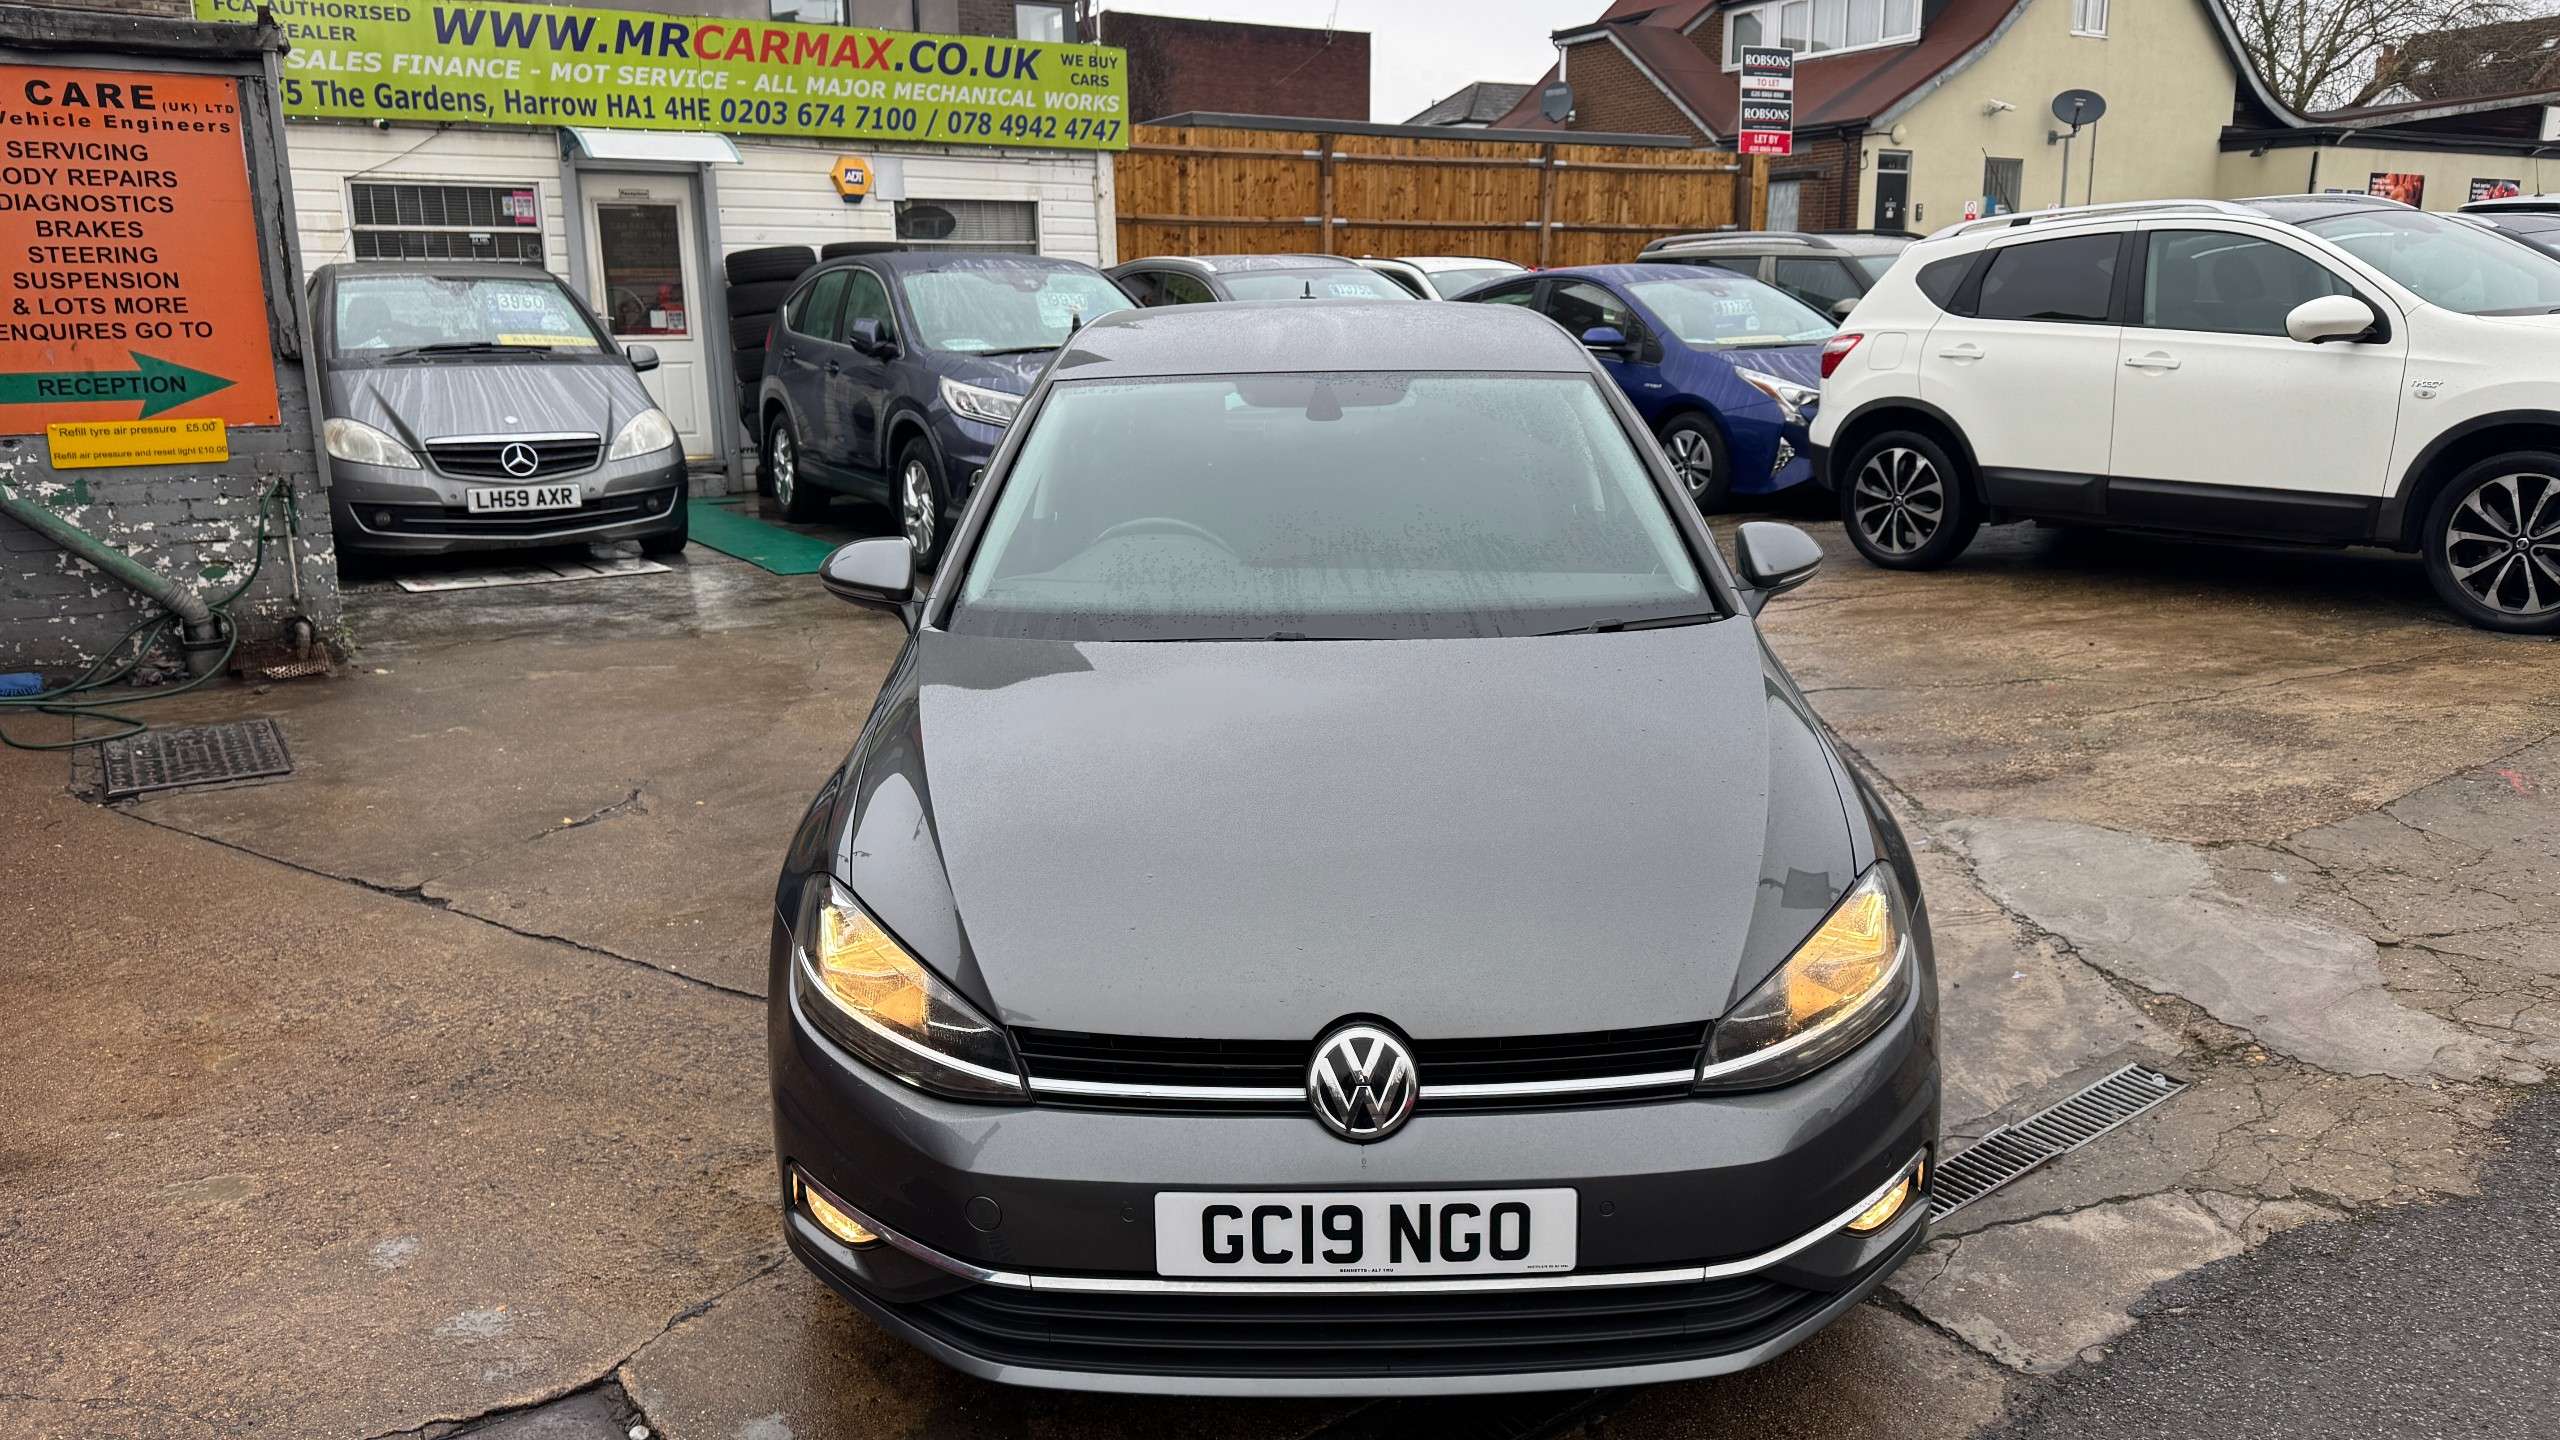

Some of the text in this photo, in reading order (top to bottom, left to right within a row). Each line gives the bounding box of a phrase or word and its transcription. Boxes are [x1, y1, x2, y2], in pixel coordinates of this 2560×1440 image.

[213, 0, 411, 22] FCA AUTHORISED
[286, 23, 357, 42] EALER
[433, 7, 1042, 80] WWW.MRCARMAX.CO.UK
[1061, 53, 1118, 69] WE BUY
[1745, 54, 1791, 68] ROBSONS
[287, 49, 381, 72] SALES
[393, 53, 521, 80] FINANCE
[551, 62, 610, 83] MOT
[617, 66, 729, 90] SERVICE
[754, 73, 797, 94] ALL
[806, 76, 886, 99] MAJOR
[893, 82, 1036, 108] MECHANICAL
[1044, 91, 1120, 112] WORKS
[1070, 73, 1109, 87] CARS
[25, 79, 235, 114] CARE (UK) LTD
[279, 77, 1121, 142] 5 The Gardens, Harrow HA1 4HE 0203 674 7100 / 078 4942 4747
[1744, 107, 1790, 121] ROBSONS
[104, 114, 231, 133] Engineers
[6, 141, 148, 162] SERVICING
[0, 167, 178, 188] ODY REPAIRS
[845, 170, 863, 183] ADT
[36, 220, 144, 239] BRAKES
[28, 246, 158, 264] STEERING
[13, 272, 180, 289] SUSPENSION
[13, 297, 188, 315] & LOTS MORE
[135, 322, 172, 339] GO
[180, 321, 213, 338] TO
[37, 375, 187, 396] RECEPTION
[59, 427, 87, 438] Refill
[90, 425, 110, 438] tyre
[114, 424, 127, 435] air
[130, 424, 177, 437] pressure
[53, 450, 77, 461] Refill
[80, 450, 90, 459] air
[93, 449, 132, 461] pressure
[135, 448, 151, 458] and
[153, 447, 175, 457] reset
[177, 445, 196, 457] light
[476, 487, 572, 509] LH59 AXR
[1202, 1201, 1531, 1265] GC19 NGO
